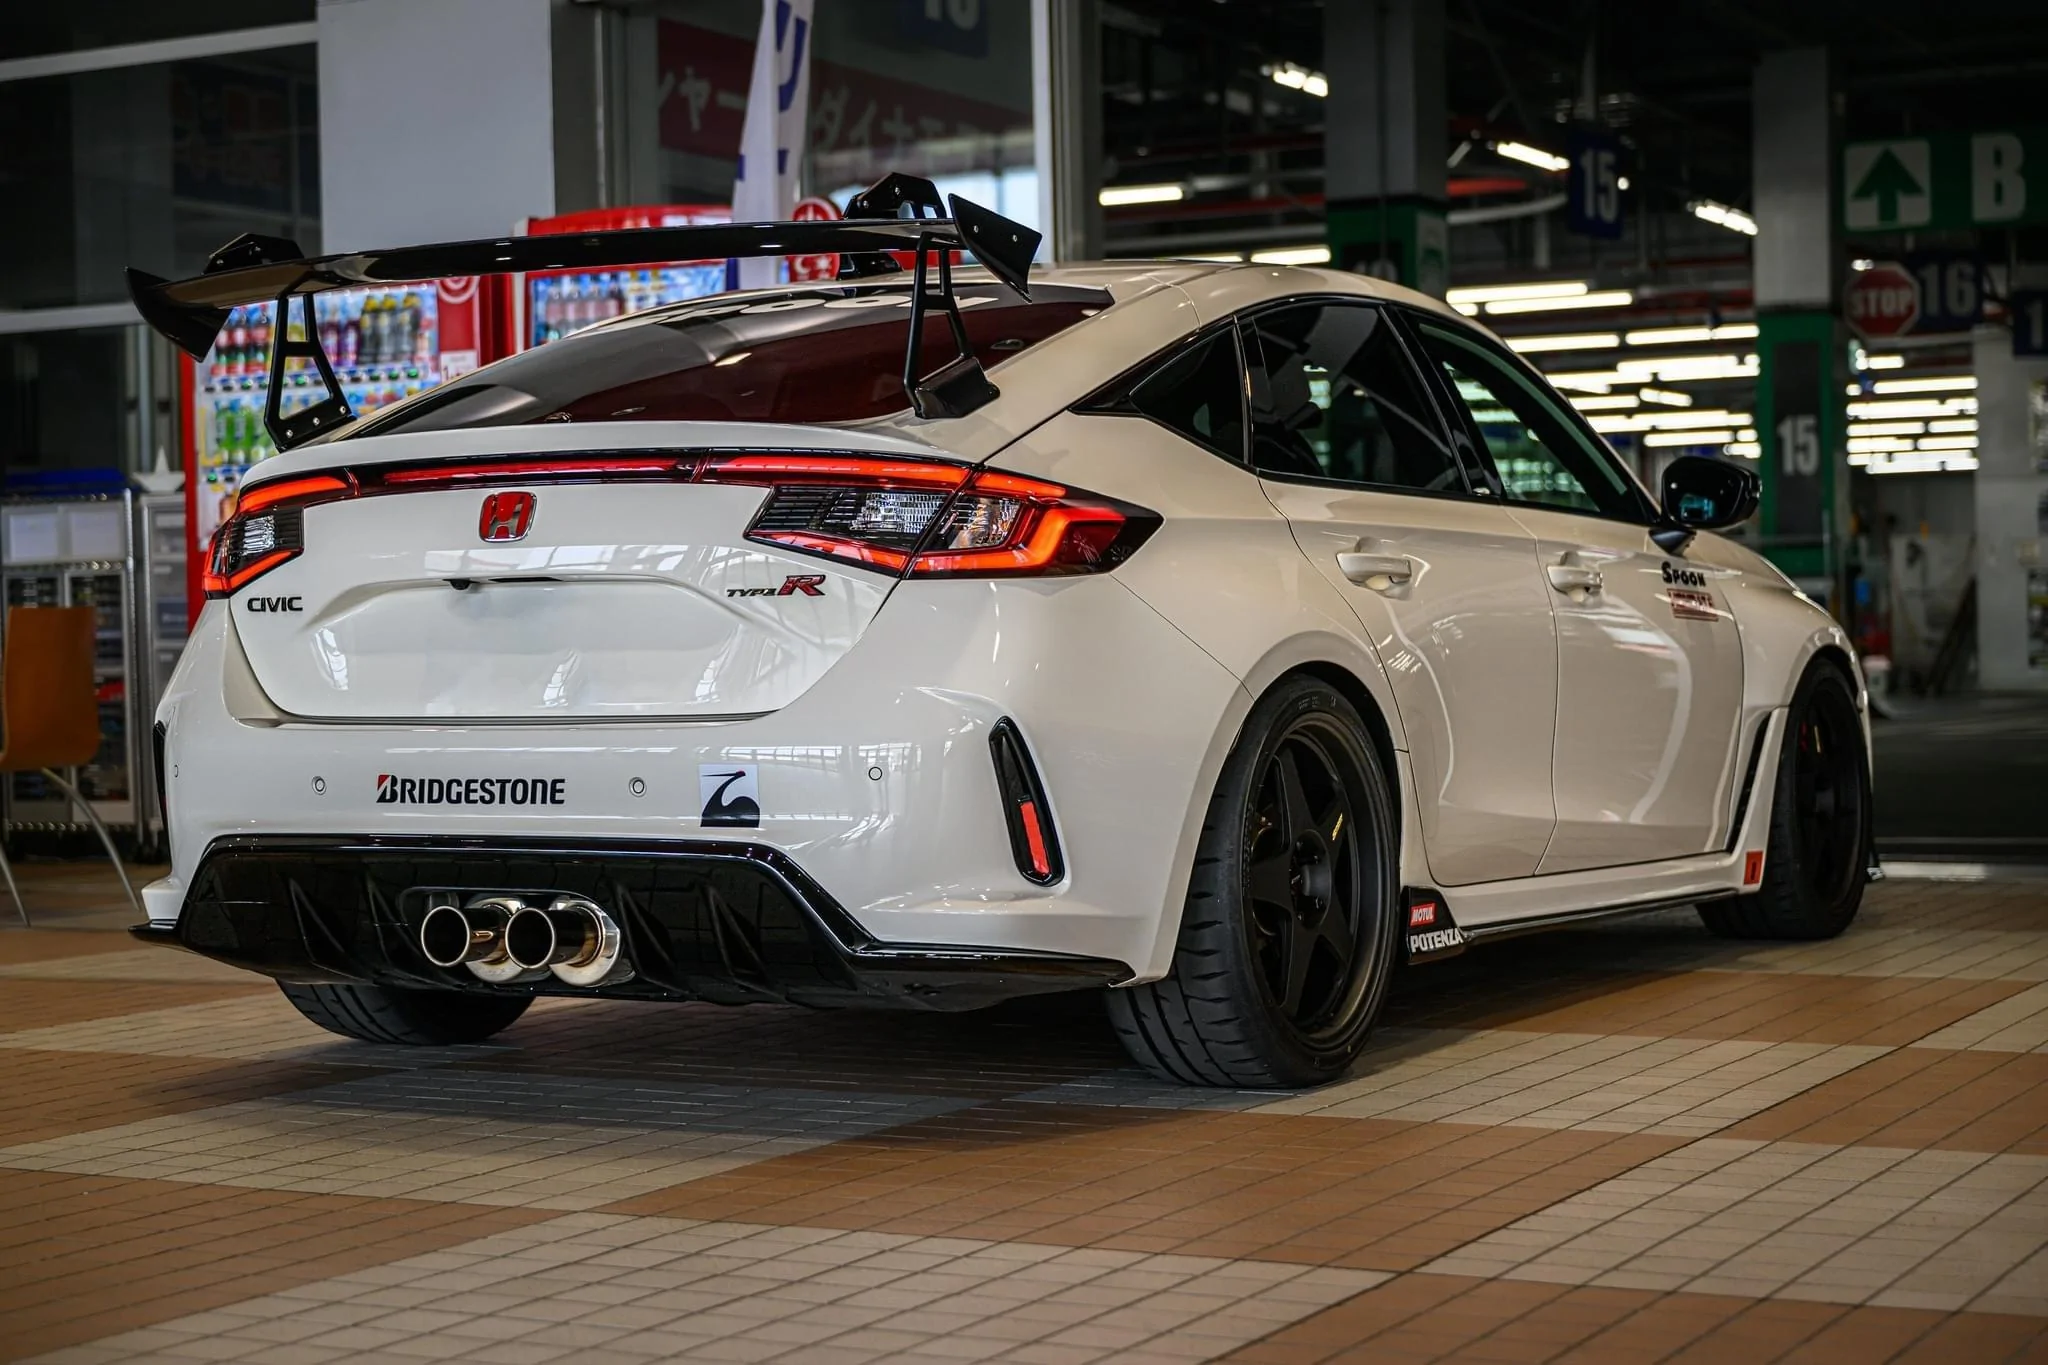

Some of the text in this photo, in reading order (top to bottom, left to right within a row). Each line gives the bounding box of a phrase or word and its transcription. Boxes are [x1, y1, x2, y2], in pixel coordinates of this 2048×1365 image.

[1578, 146, 1619, 224] 15
[1971, 132, 2027, 223] B
[1850, 286, 1913, 319] STOP
[1917, 258, 1978, 318] 16
[1777, 414, 1820, 477] 15
[726, 574, 826, 598] TYPE R
[247, 596, 304, 613] CIVIC
[375, 774, 566, 804] BRIDGESTONE
[1411, 906, 1434, 922] MOTUL
[1410, 927, 1465, 954] POTENZA
